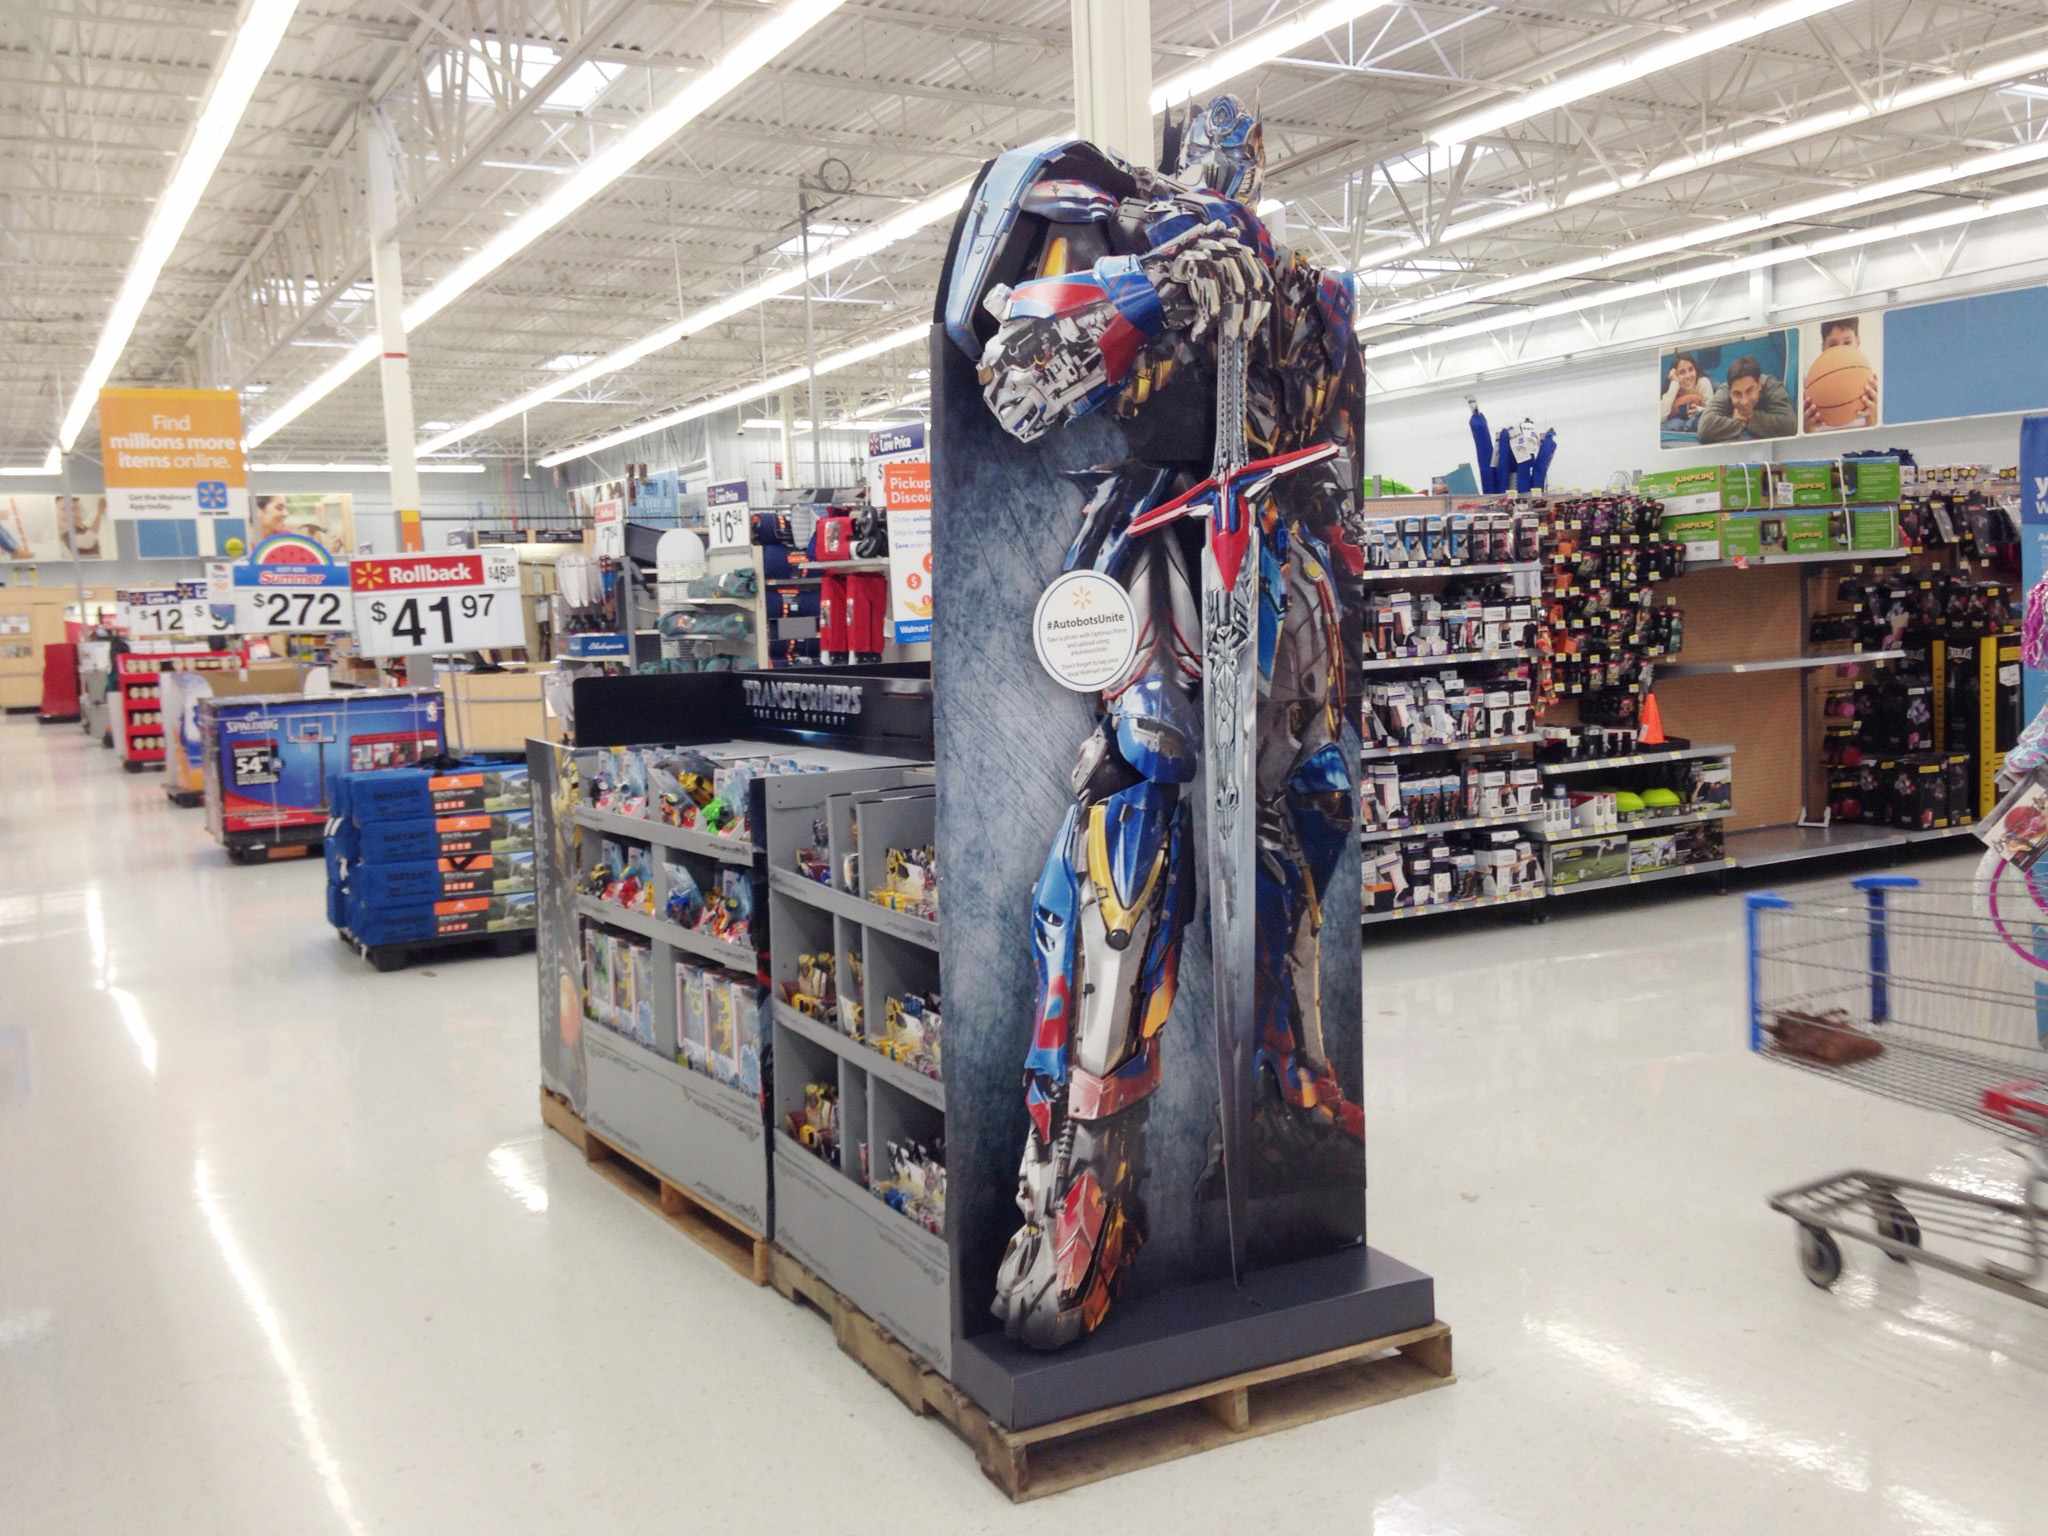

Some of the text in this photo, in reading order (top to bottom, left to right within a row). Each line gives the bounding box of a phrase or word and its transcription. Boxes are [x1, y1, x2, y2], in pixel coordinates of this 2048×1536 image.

[152, 414, 191, 431] Find
[110, 432, 236, 449] millions more
[895, 435, 912, 449] Price
[118, 451, 231, 468] items online.
[890, 477, 931, 492] Pickup
[259, 571, 327, 585] Summer
[388, 562, 472, 584] Rollback
[1047, 613, 1126, 630] #AutobotsUnite
[742, 680, 863, 714] TRANSFORMERS
